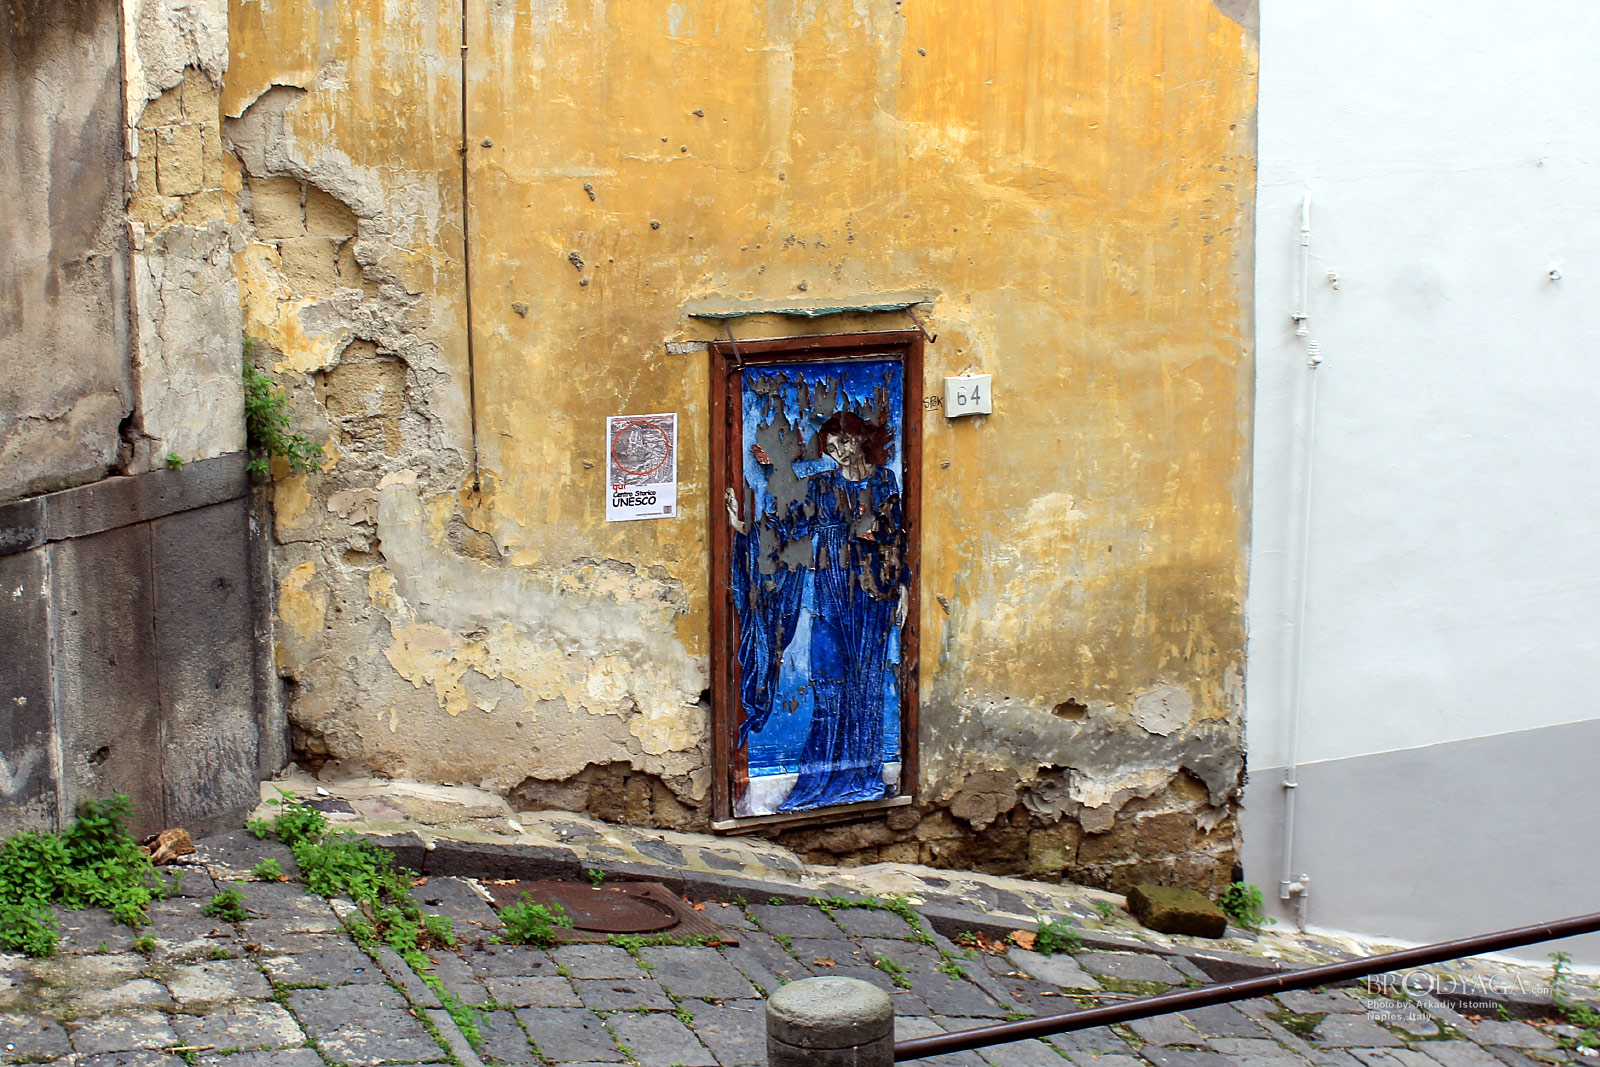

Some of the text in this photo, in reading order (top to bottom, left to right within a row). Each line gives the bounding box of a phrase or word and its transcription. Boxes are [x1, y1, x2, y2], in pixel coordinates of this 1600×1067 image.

[957, 385, 981, 406] 64
[612, 483, 626, 492] qui
[612, 496, 657, 507] UNESCO
